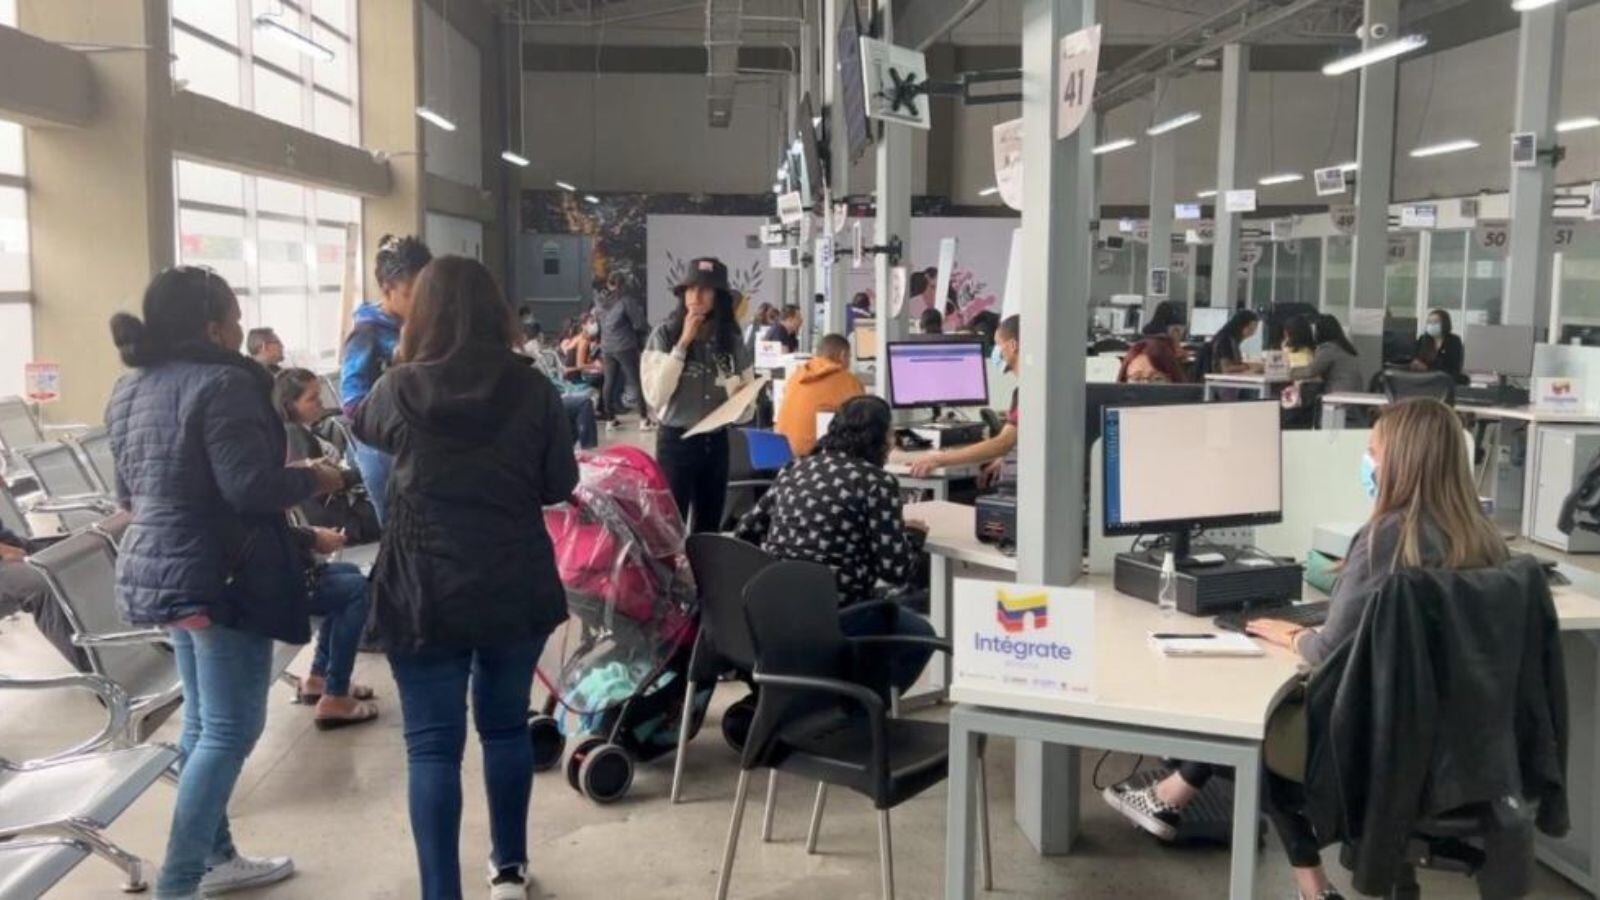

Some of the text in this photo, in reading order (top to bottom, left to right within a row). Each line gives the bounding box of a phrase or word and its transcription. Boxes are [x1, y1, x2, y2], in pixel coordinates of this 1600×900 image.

[1064, 68, 1085, 107] 41
[1484, 231, 1507, 247] 50
[1554, 229, 1574, 245] 51
[974, 632, 1073, 660] Intégrate
